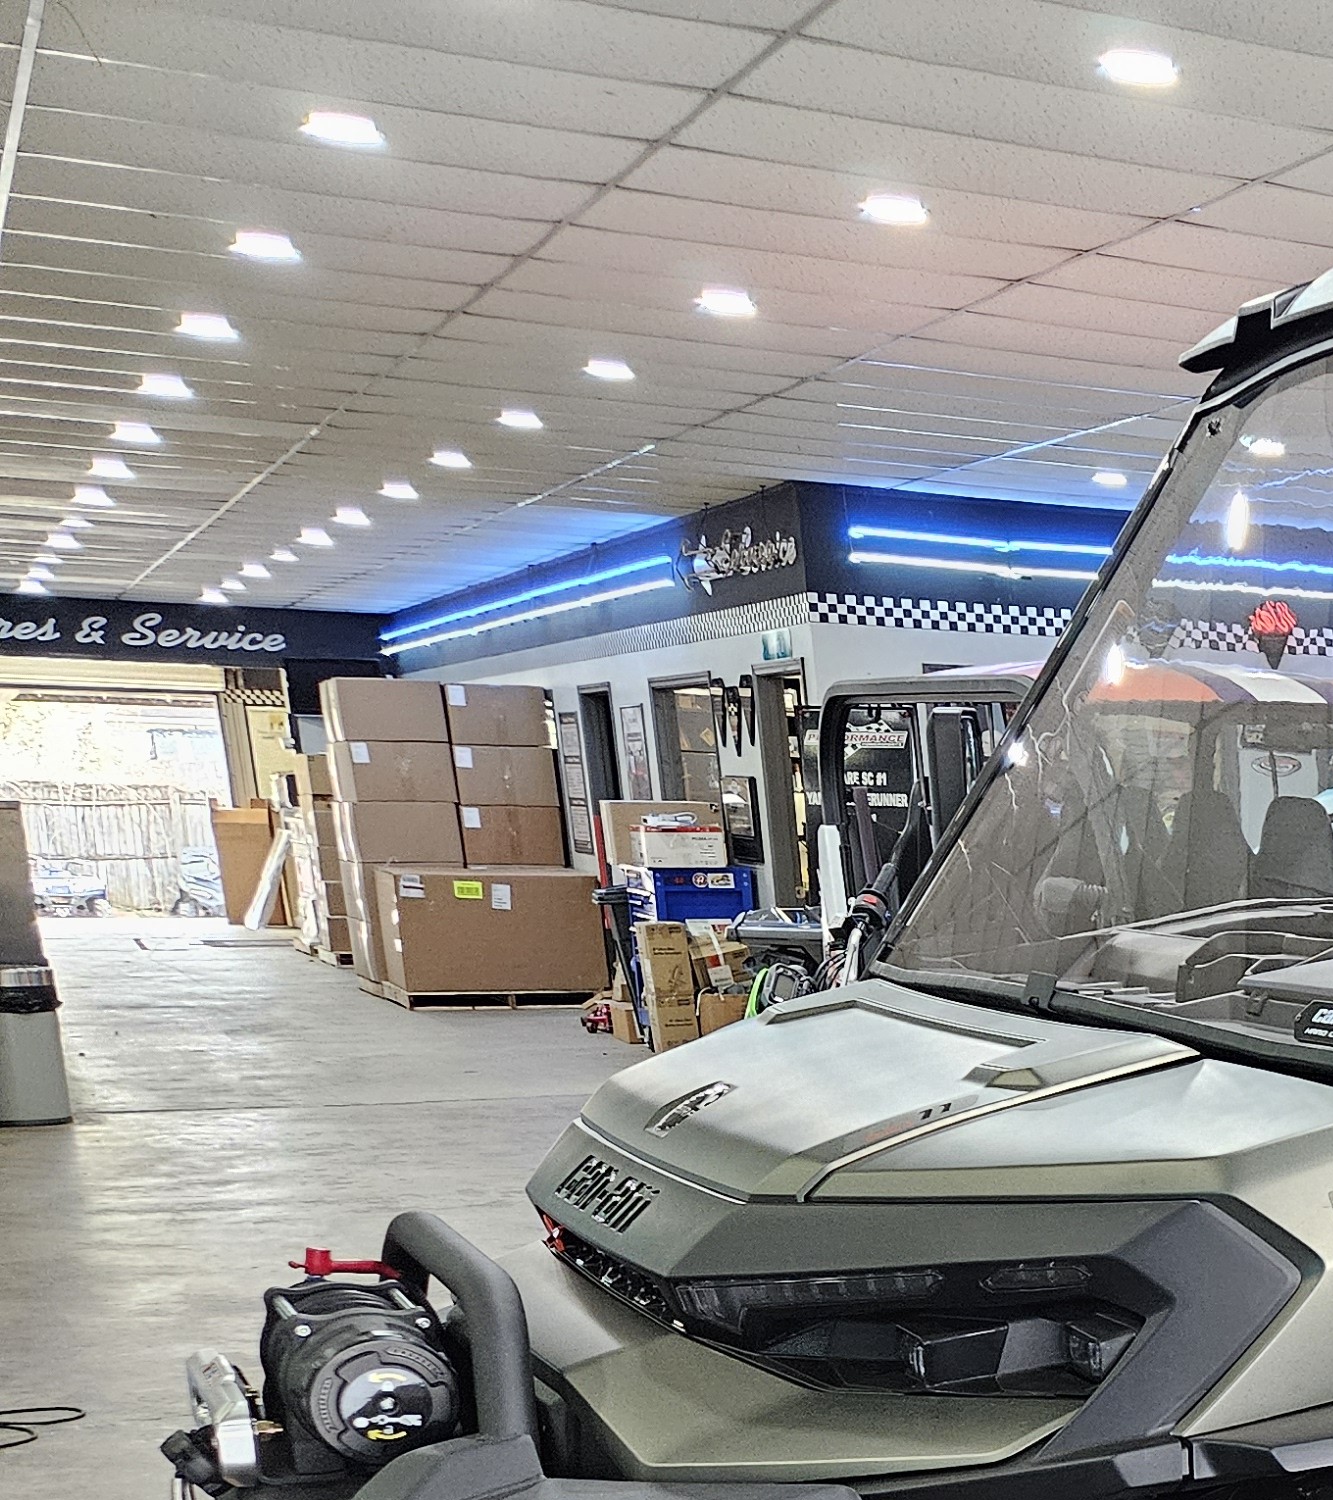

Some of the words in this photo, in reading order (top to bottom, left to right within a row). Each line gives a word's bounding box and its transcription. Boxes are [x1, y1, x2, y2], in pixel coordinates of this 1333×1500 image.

[75, 615, 108, 645] &
[121, 612, 287, 652] Service
[807, 733, 905, 743] PRMANCE
